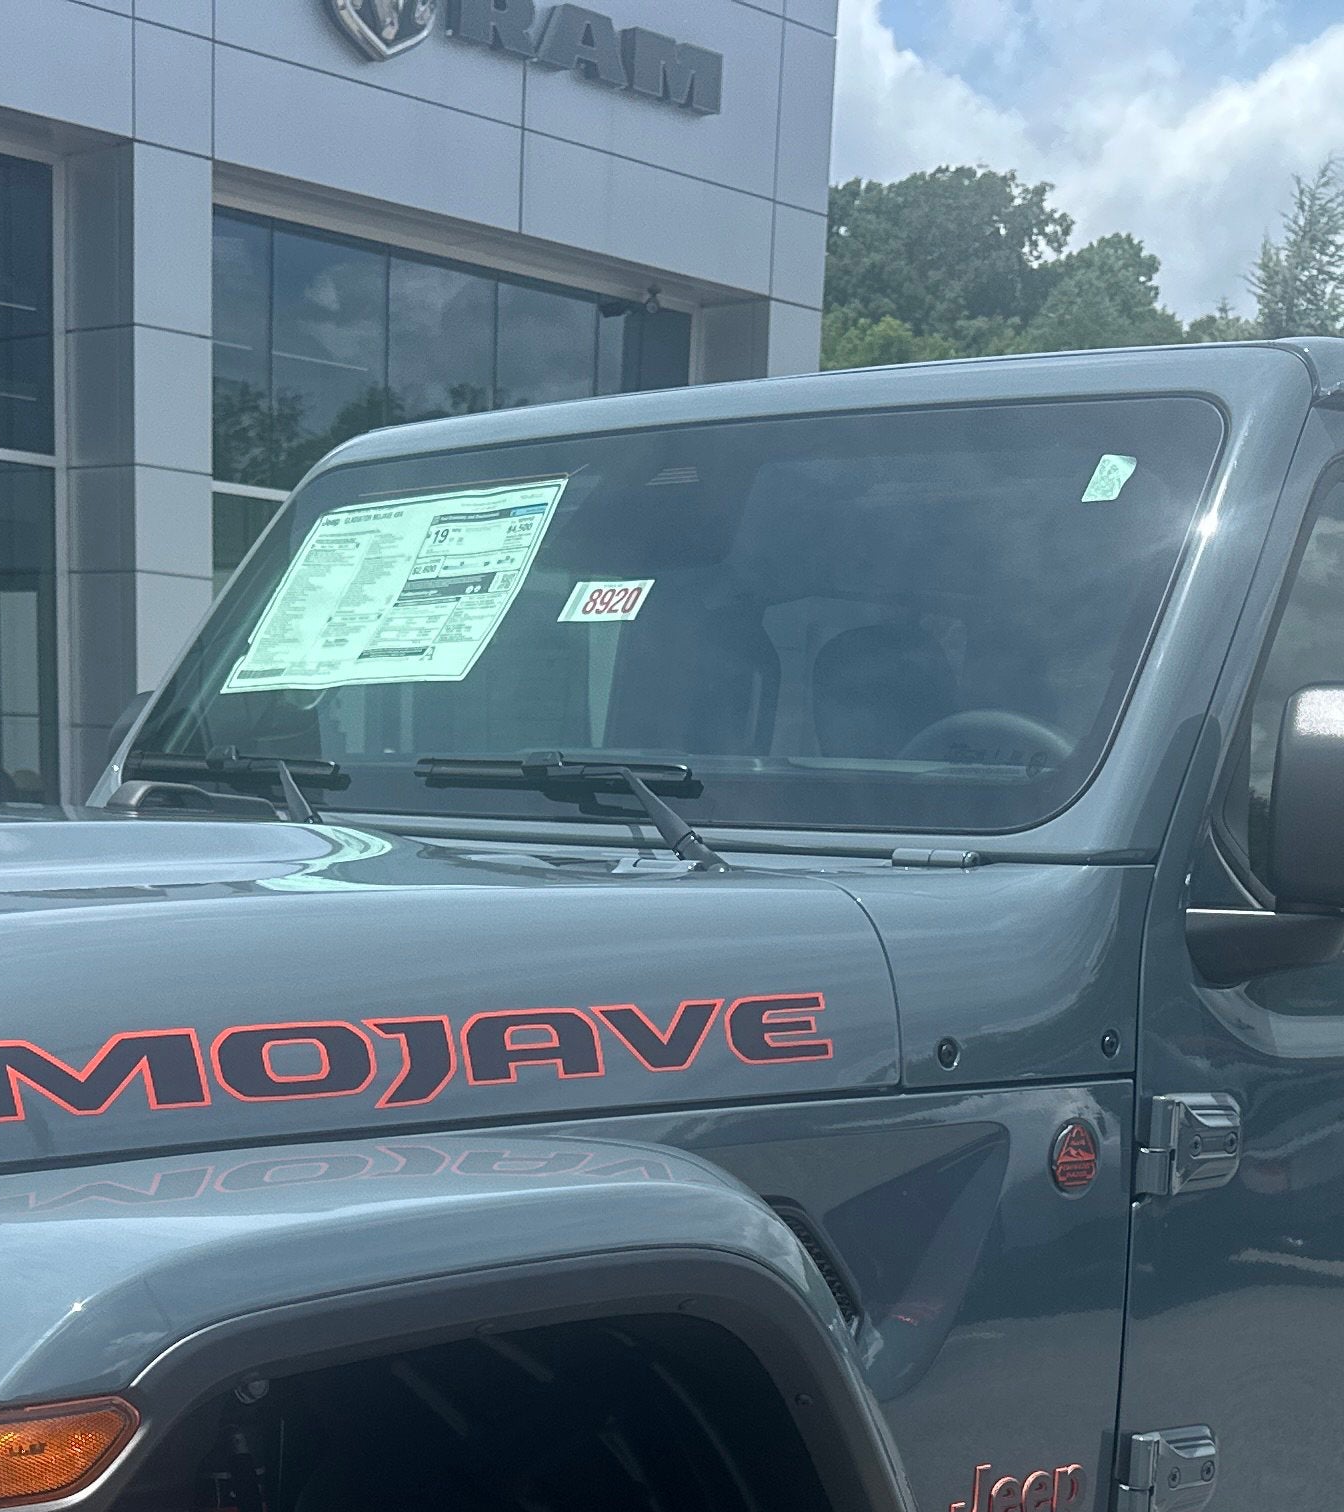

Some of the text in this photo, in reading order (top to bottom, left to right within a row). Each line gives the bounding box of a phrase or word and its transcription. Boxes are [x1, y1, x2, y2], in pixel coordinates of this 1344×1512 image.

[446, 0, 723, 114] RAM
[433, 528, 450, 544] 19
[582, 586, 643, 615] 8920
